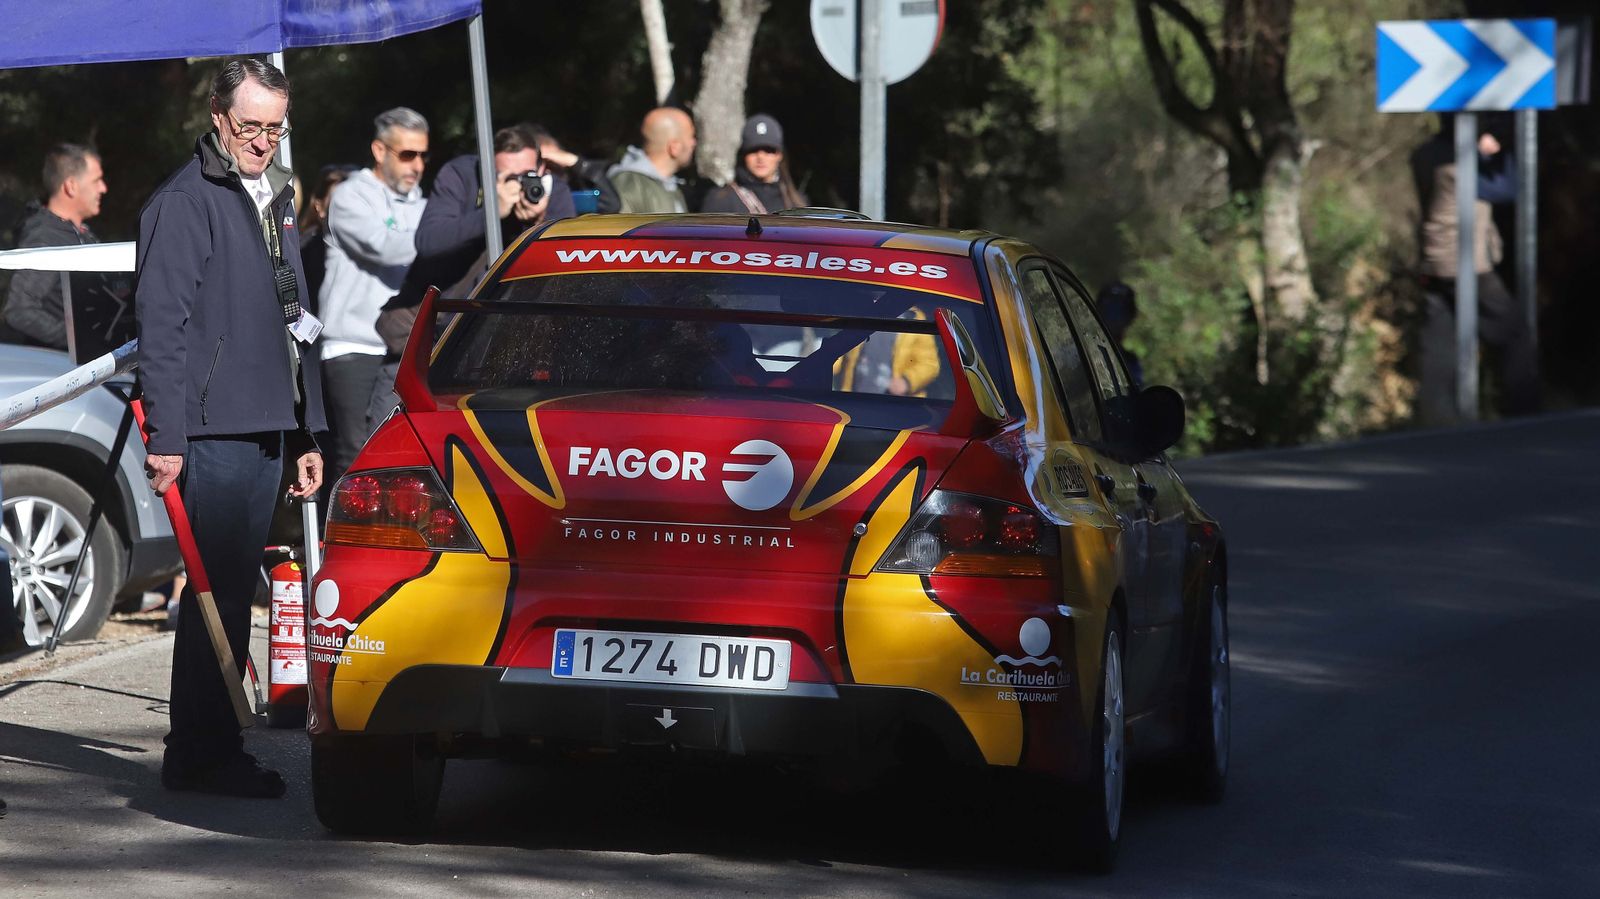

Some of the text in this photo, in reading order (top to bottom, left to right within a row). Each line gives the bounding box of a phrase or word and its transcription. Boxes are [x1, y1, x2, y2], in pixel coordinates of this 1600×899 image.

[555, 248, 948, 279] www.rosales.es
[568, 446, 706, 481] FAGOR
[565, 527, 794, 548] FAGOR INDUSTRIAL
[310, 630, 343, 648] ihuela
[347, 634, 385, 651] Chica
[560, 657, 568, 668] E
[583, 636, 774, 682] 1274 DWD
[961, 667, 981, 682] La
[986, 668, 1055, 686] Carihuela
[997, 691, 1059, 702] RESTAURANTE
